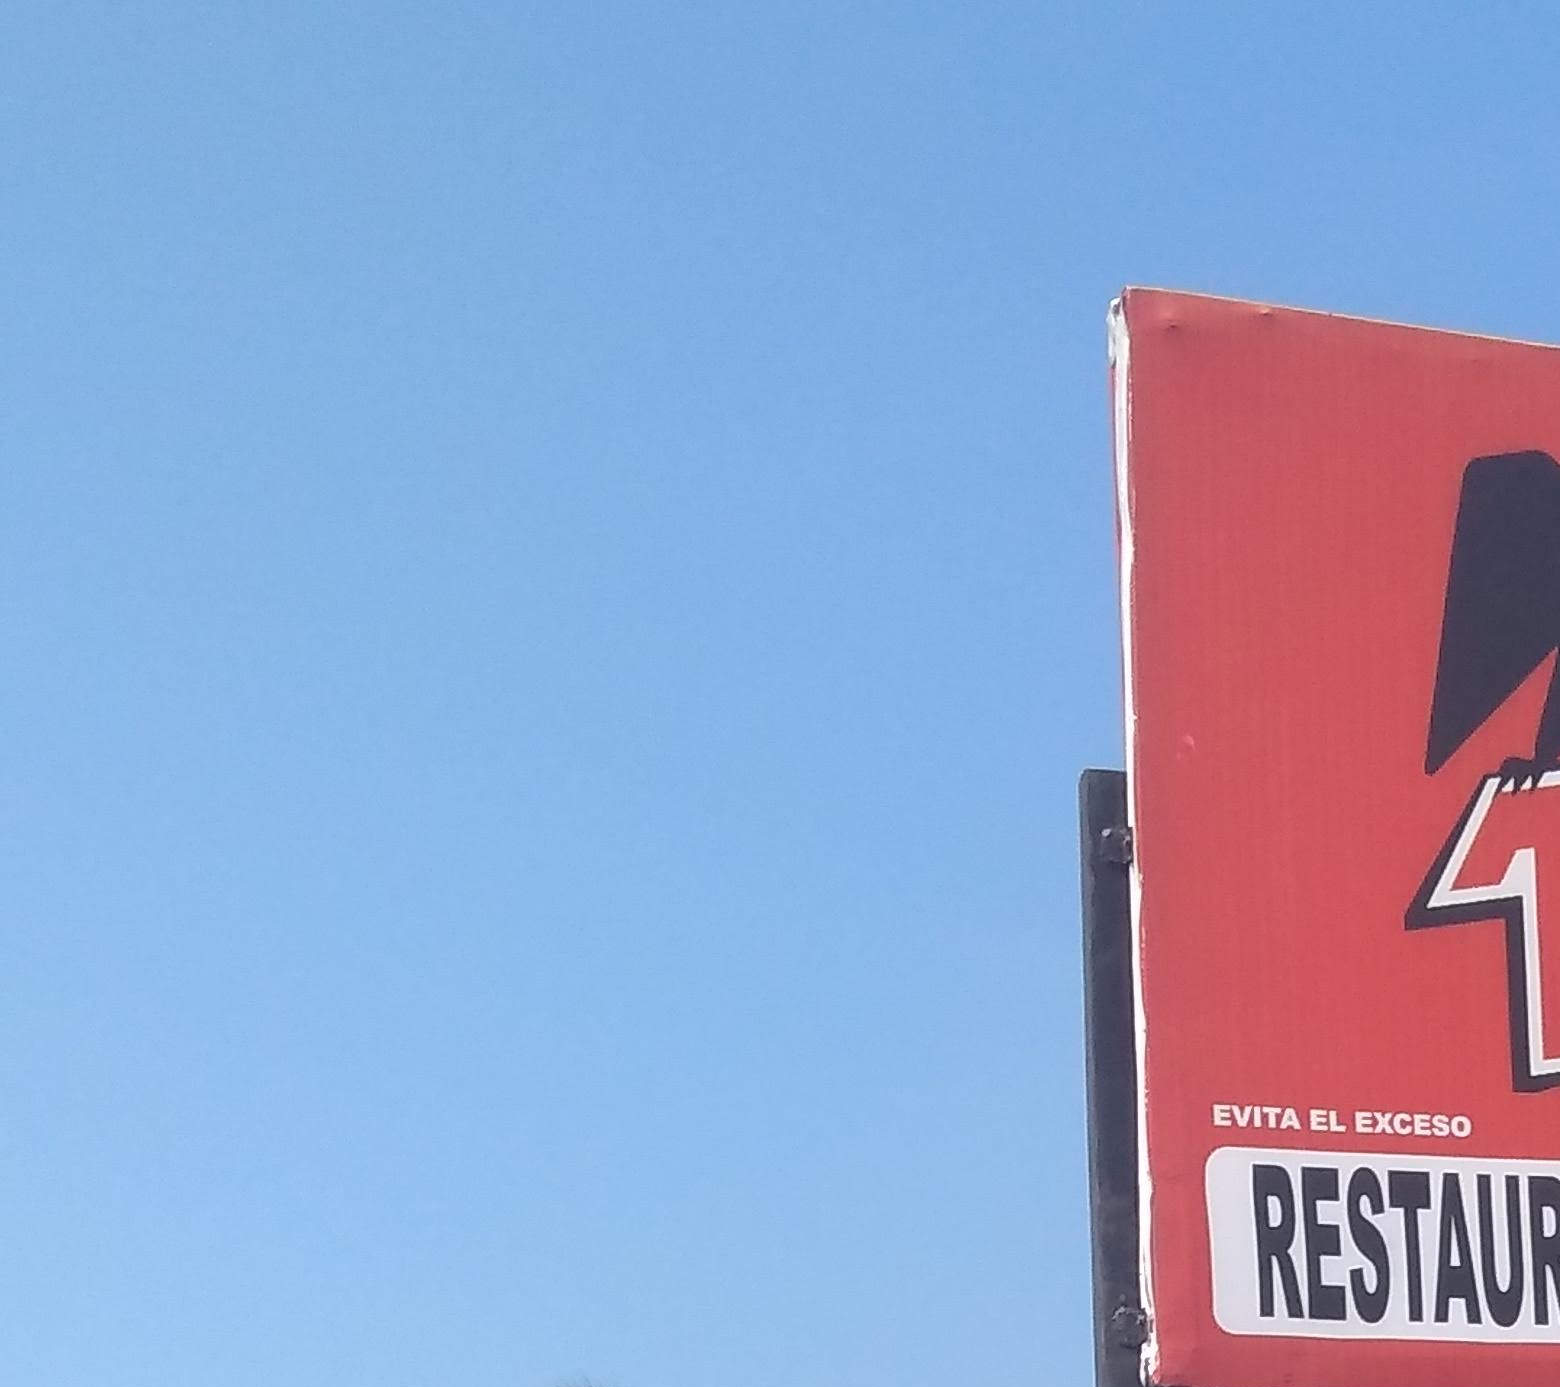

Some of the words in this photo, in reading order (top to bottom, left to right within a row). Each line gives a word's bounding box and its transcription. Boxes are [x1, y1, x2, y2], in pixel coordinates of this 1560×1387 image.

[1212, 1103, 1301, 1130] EVITA
[1309, 1109, 1346, 1133] EL
[1354, 1111, 1472, 1138] EXCESO
